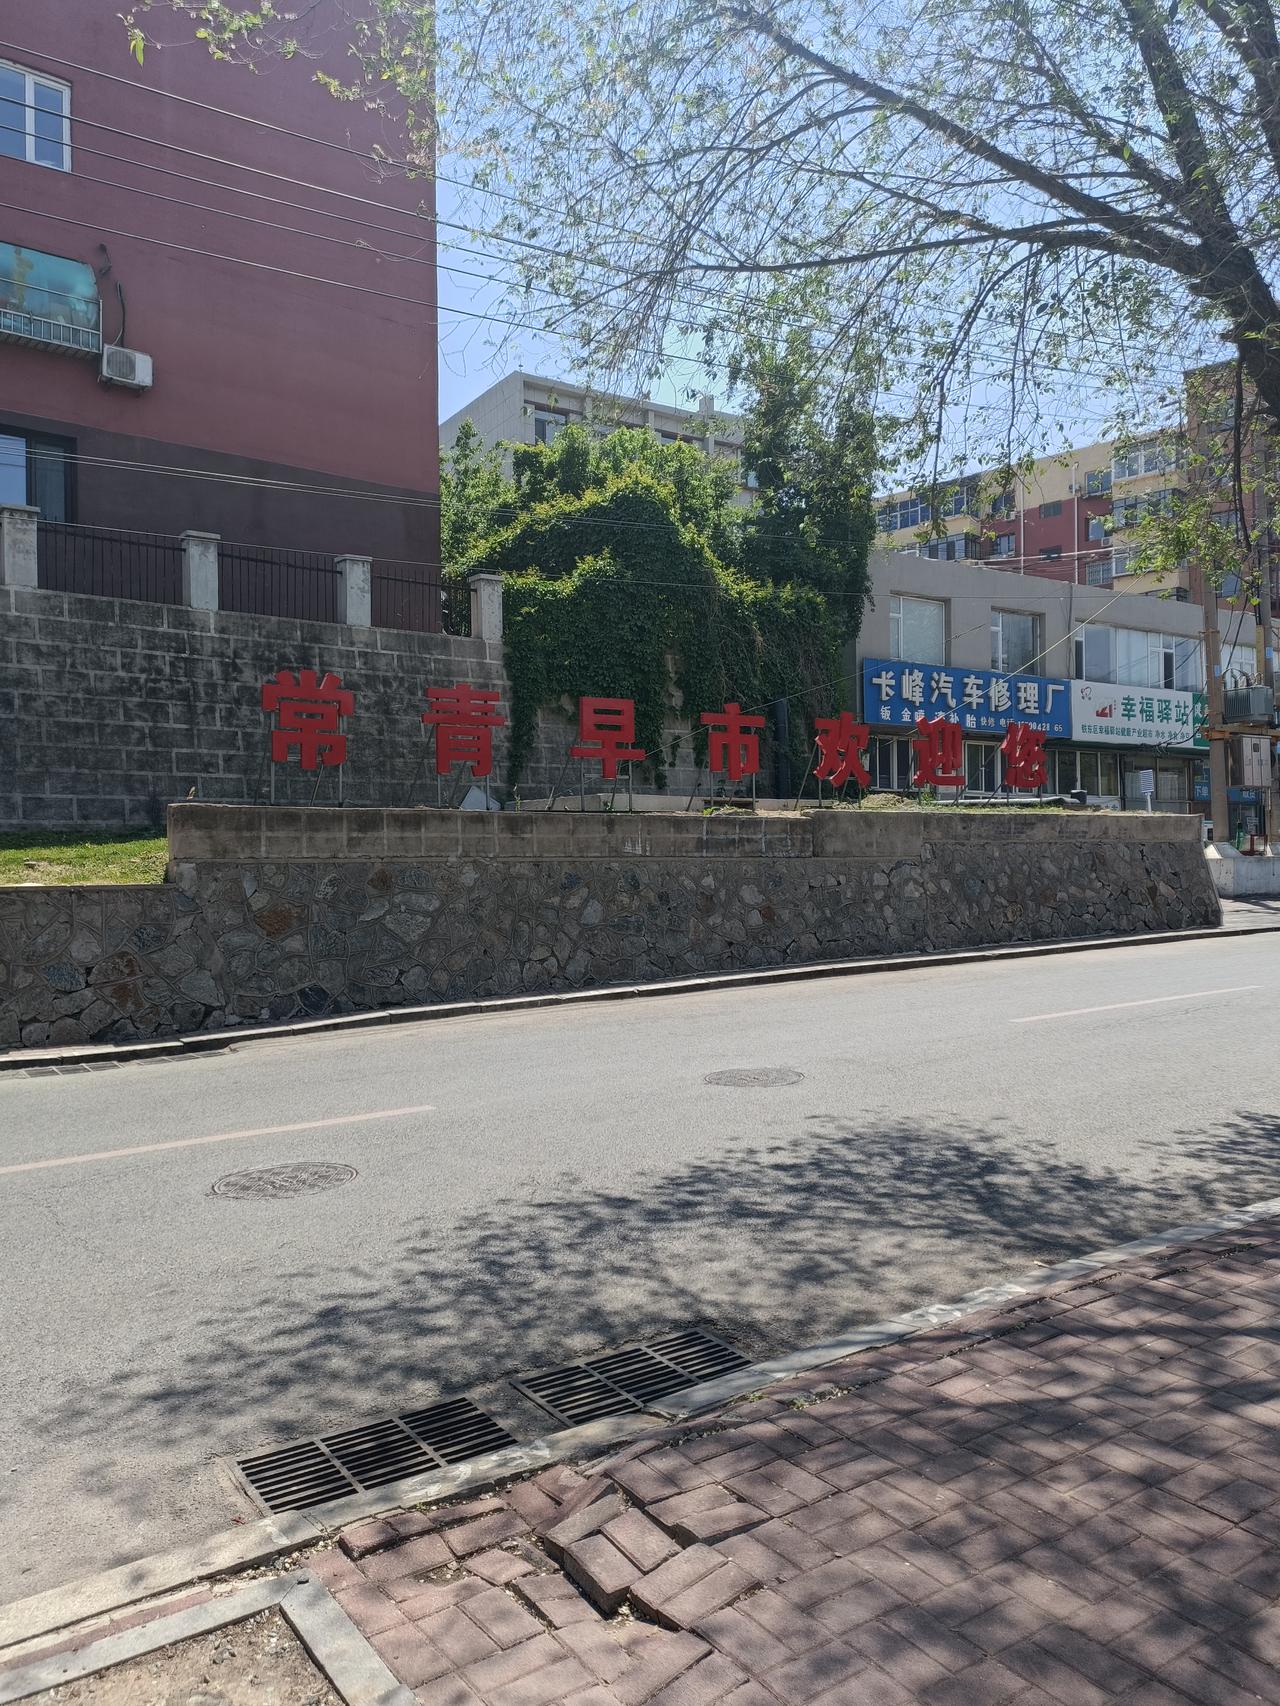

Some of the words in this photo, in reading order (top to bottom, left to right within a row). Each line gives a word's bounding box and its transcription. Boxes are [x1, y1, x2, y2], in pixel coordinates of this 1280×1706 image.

[872, 669, 1065, 714] 长峰汽车修理厂
[1121, 695, 1189, 726] 幸福驿站
